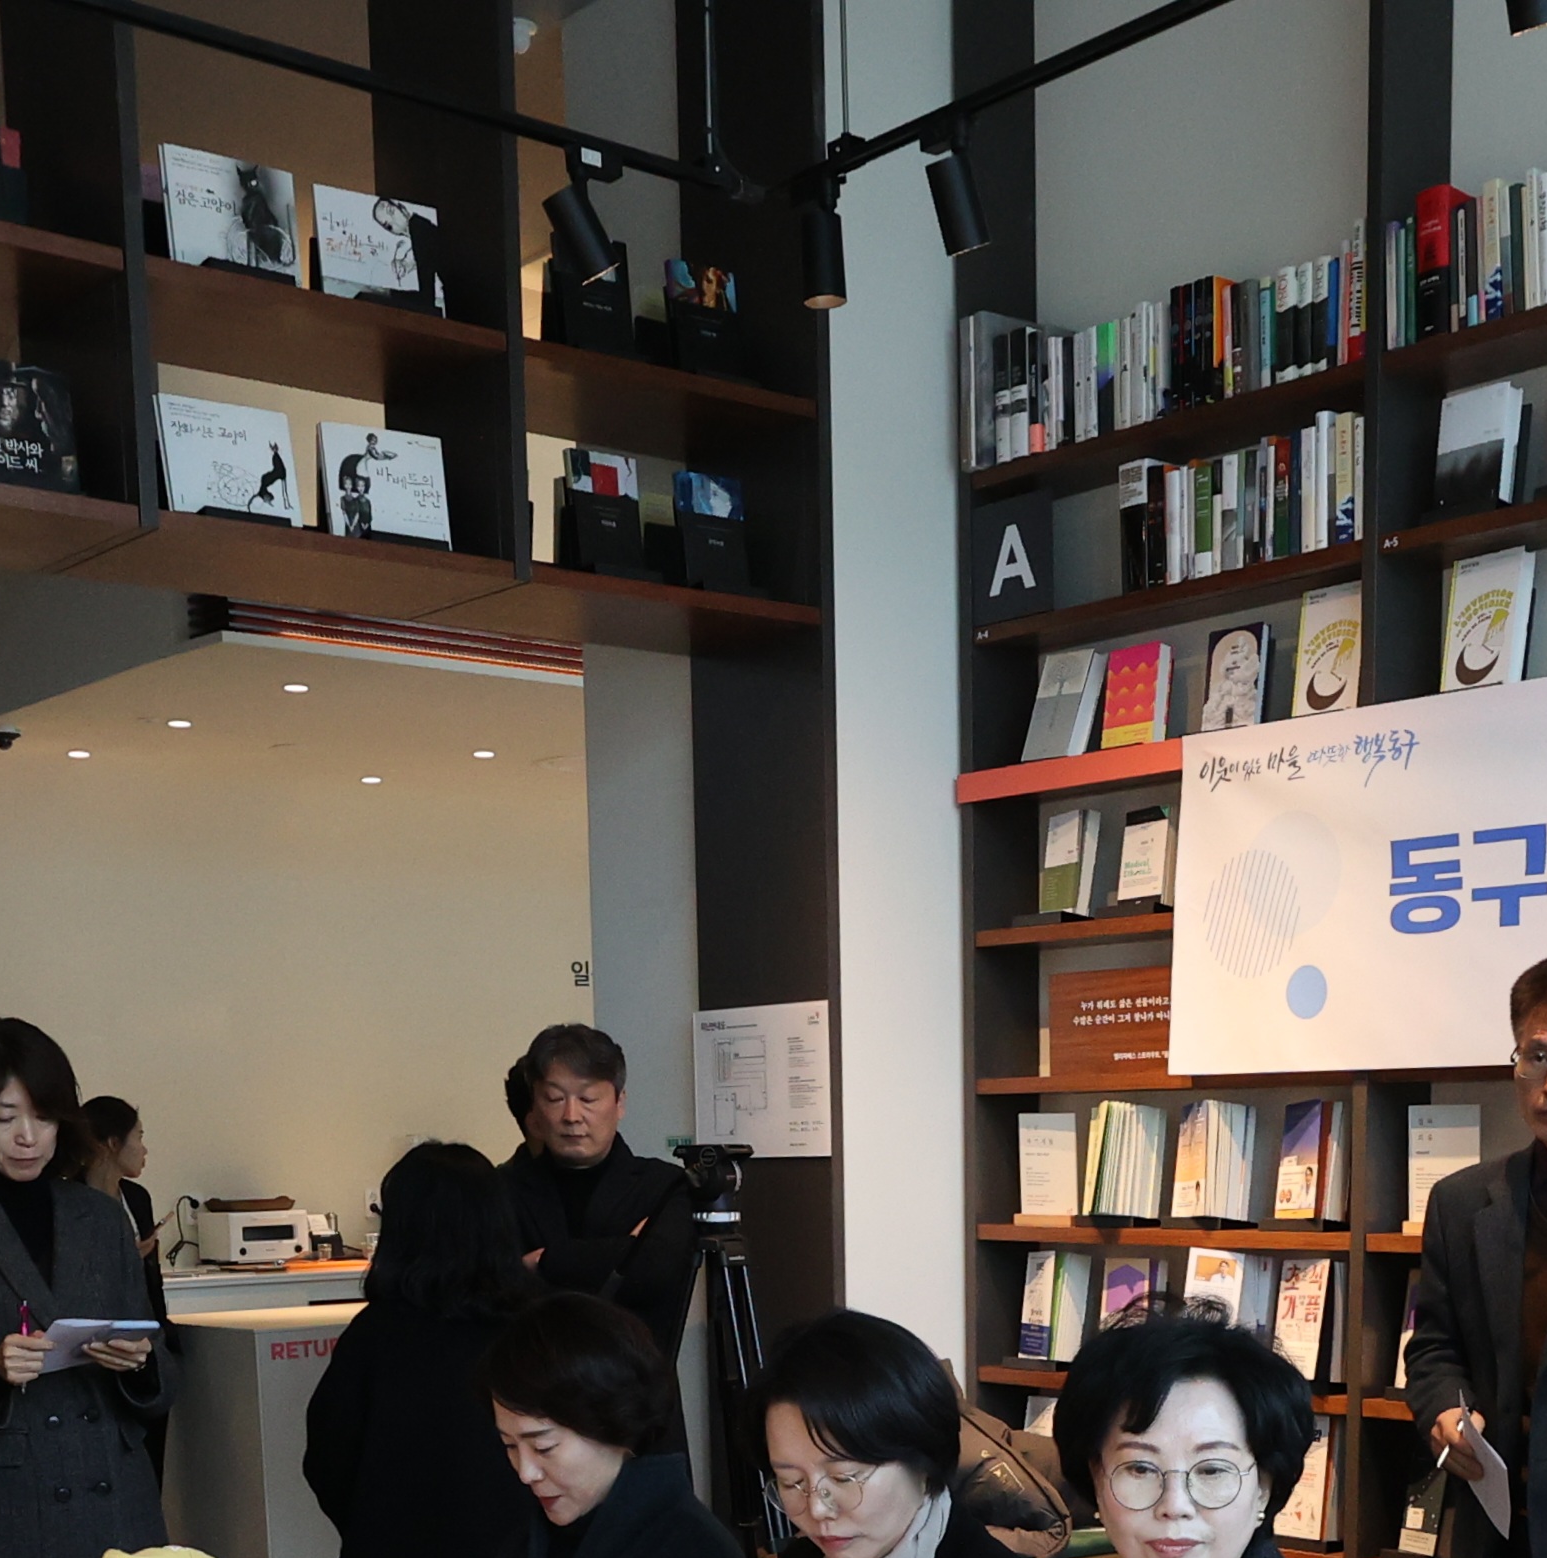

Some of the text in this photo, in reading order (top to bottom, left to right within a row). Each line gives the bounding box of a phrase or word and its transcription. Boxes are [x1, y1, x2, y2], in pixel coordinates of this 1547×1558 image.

[5, 437, 44, 460] 박사와
[1383, 537, 1399, 550] A-5
[989, 523, 1036, 598] A
[570, 960, 590, 987] 일
